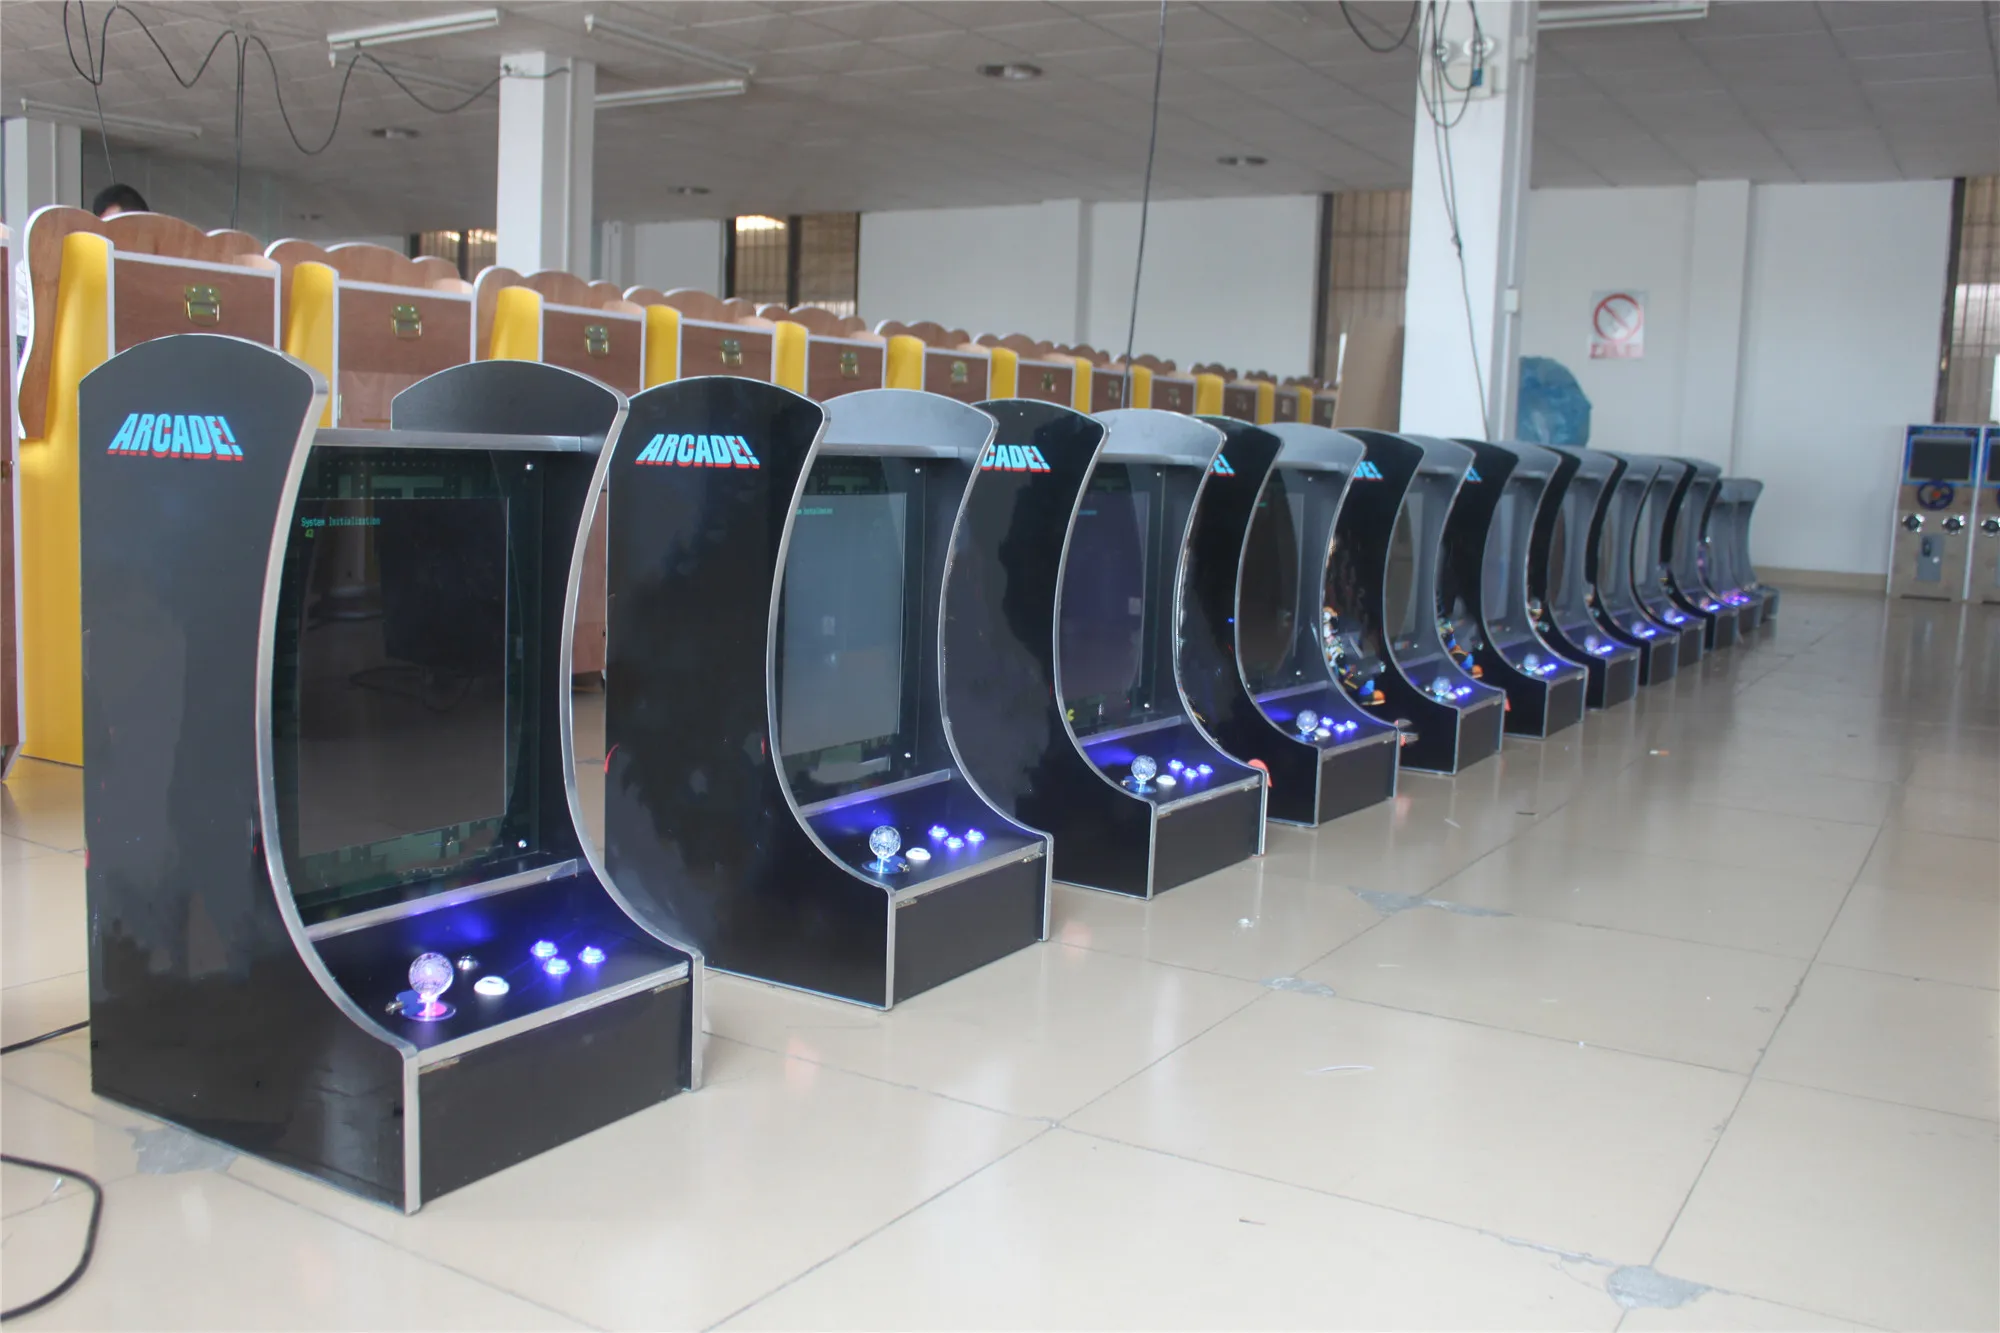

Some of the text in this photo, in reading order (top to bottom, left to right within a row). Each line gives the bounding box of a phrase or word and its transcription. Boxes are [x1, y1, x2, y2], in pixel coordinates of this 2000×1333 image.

[106, 413, 244, 461] ARCADE!
[635, 433, 760, 469] ARCADE!
[980, 443, 1051, 473] CADE!
[301, 516, 325, 528] System
